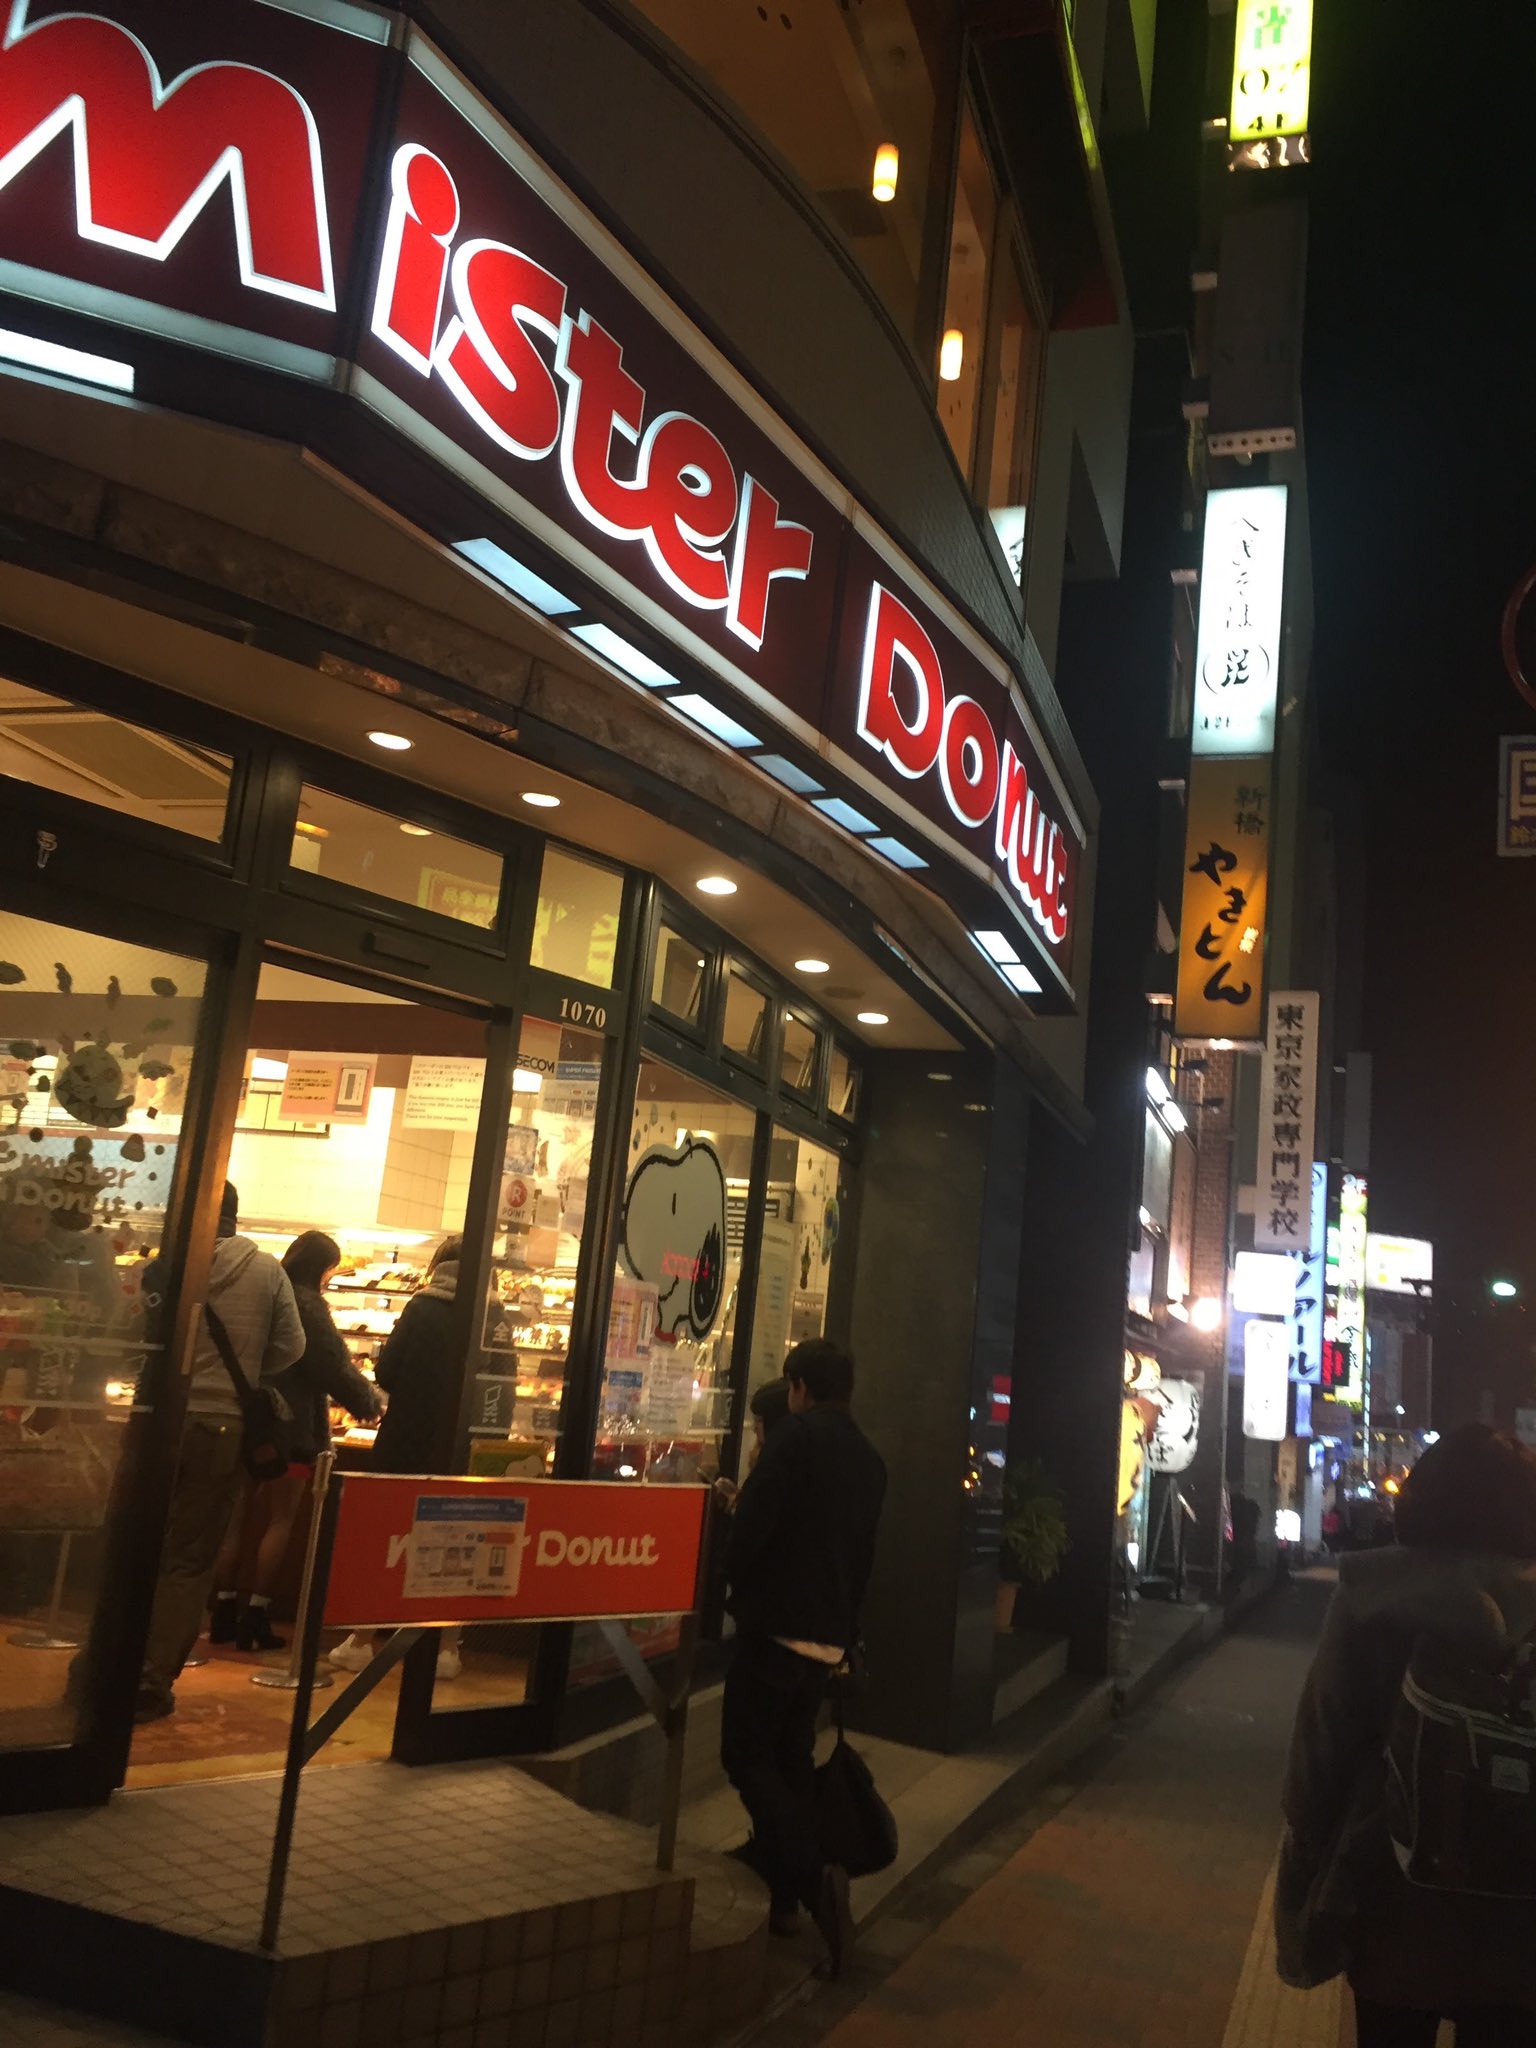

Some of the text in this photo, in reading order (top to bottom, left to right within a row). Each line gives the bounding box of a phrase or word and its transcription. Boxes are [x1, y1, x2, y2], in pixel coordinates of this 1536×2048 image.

[1189, 841, 1252, 1006] やきとん
[560, 998, 607, 1028] 1070
[517, 1054, 555, 1074] SECOM
[1270, 1003, 1305, 1237] 東京家政専門学校
[502, 1207, 526, 1219] POINT
[535, 1530, 659, 1567] Donut
